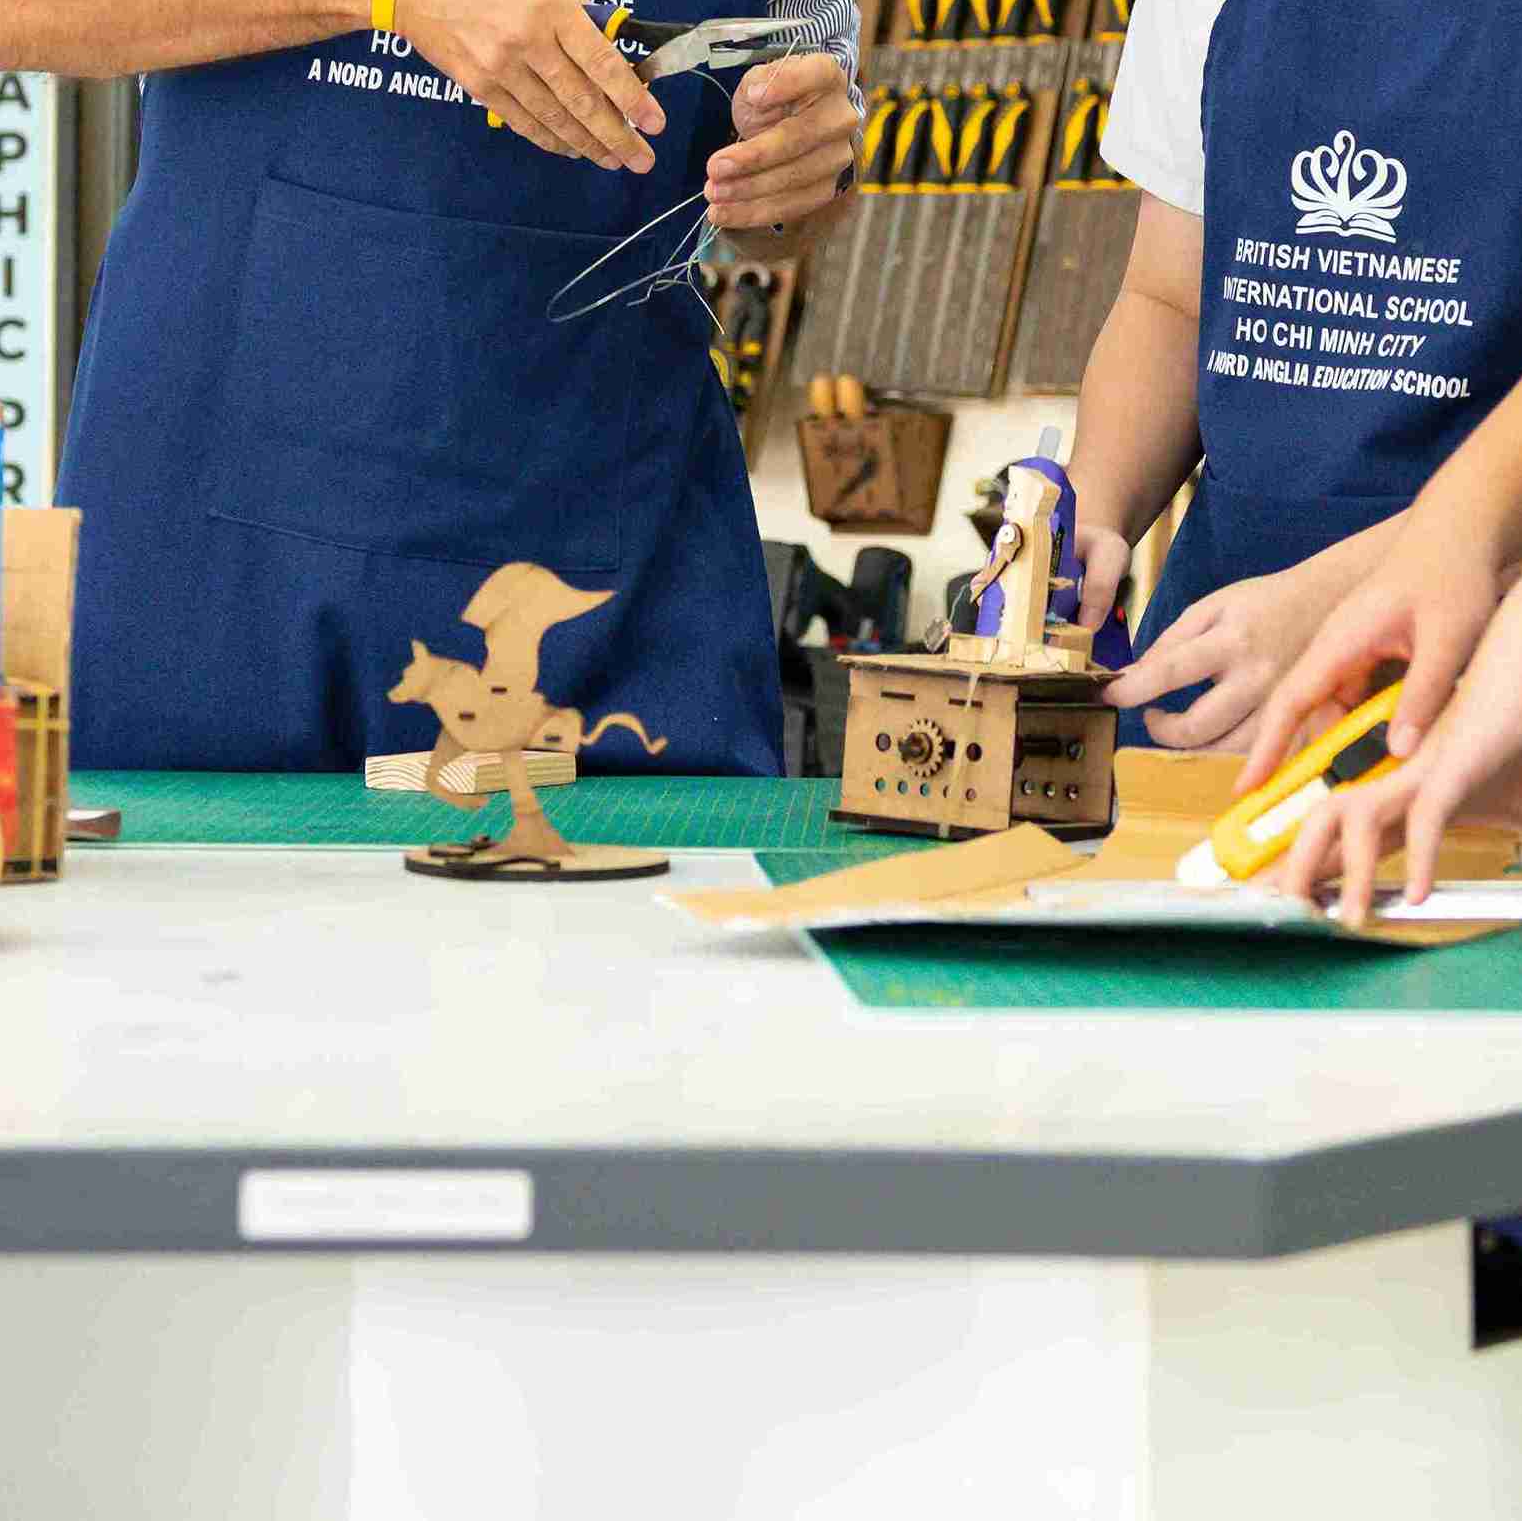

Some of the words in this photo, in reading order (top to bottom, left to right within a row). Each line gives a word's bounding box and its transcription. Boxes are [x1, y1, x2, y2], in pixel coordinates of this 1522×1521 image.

[307, 58, 321, 81] A
[328, 60, 382, 91] NORD
[388, 71, 464, 104] ANGLIA
[1235, 237, 1310, 272] BRITISH
[1317, 247, 1461, 284] VIETNAMESE
[1223, 275, 1379, 319] INTERNATIONAL
[1384, 295, 1473, 327] SCHOOL
[1235, 317, 1268, 343] HO
[1272, 322, 1312, 351] CHI
[1319, 328, 1373, 356] MINH
[1377, 333, 1427, 358] CITY
[1251, 357, 1309, 387] ANGLIA
[1312, 365, 1393, 391] EDUCATION
[1390, 369, 1472, 400] SCHOOL
